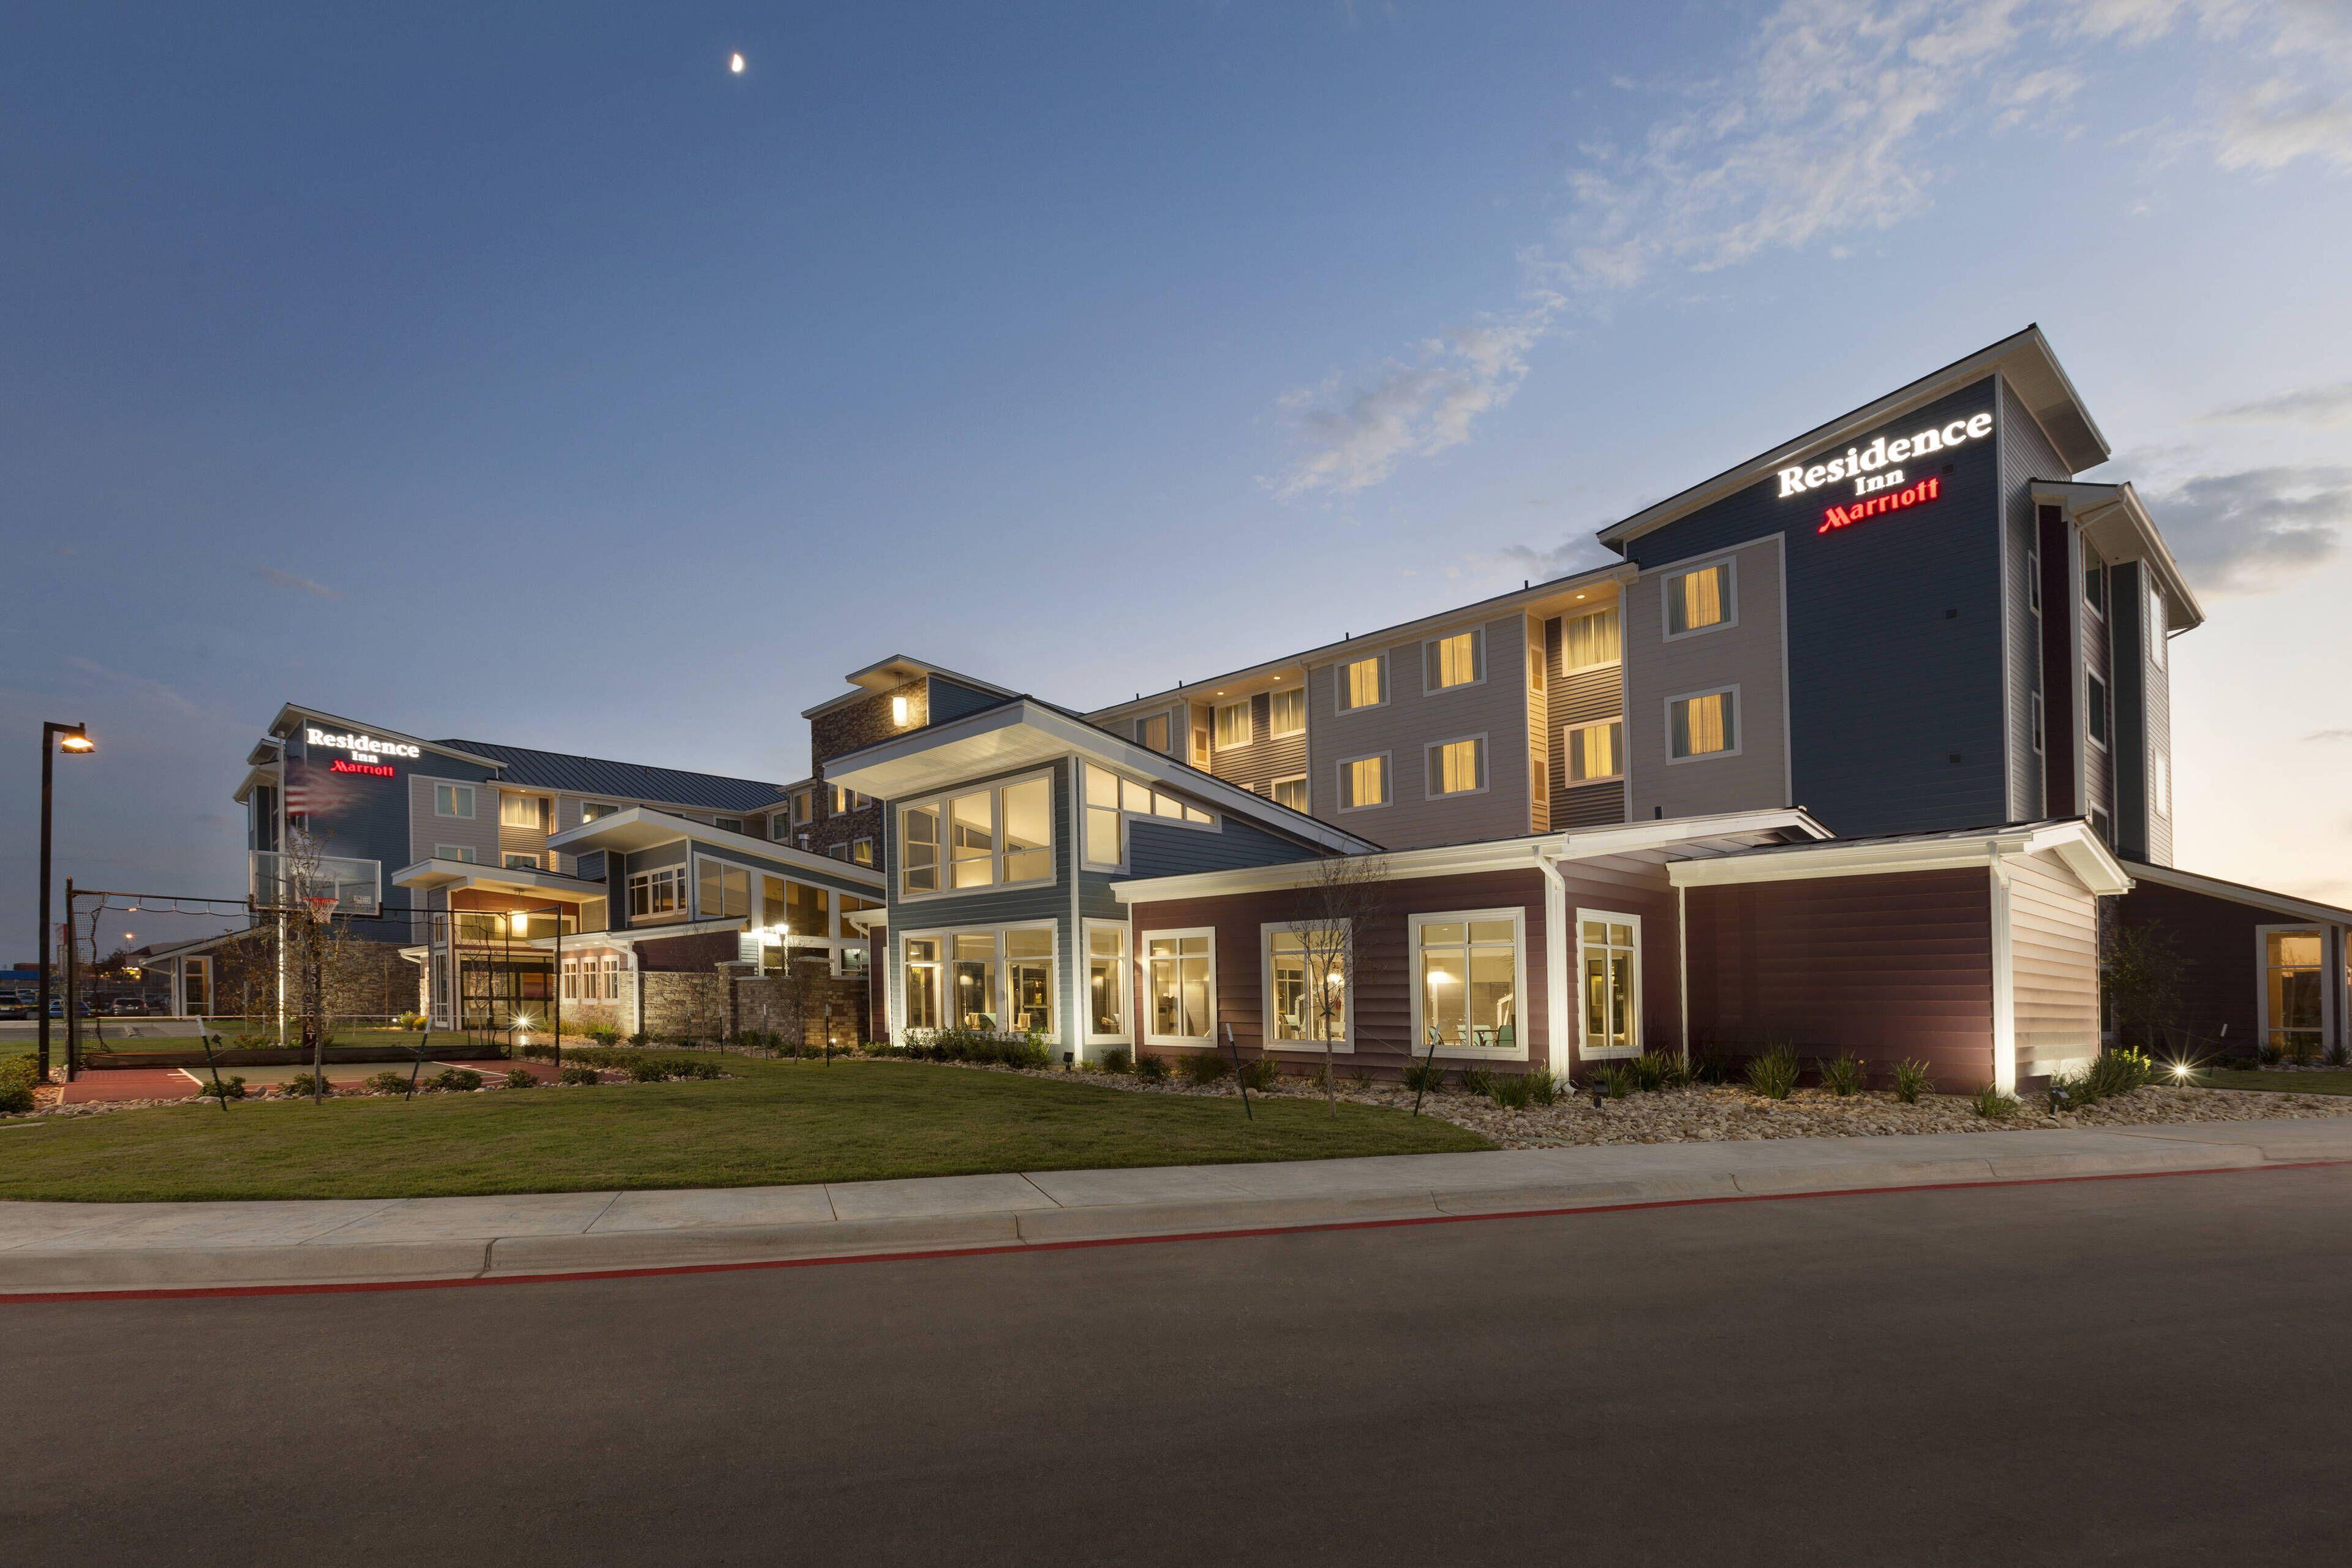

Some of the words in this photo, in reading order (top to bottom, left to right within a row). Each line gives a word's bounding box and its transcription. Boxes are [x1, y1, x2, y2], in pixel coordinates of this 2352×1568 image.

[1777, 413, 1992, 497] Residence
[1855, 470, 1905, 496] Inn
[1819, 478, 1939, 533] Marriott
[307, 728, 420, 758] Residence
[352, 751, 378, 763] Inn
[330, 760, 393, 777] Marriott
